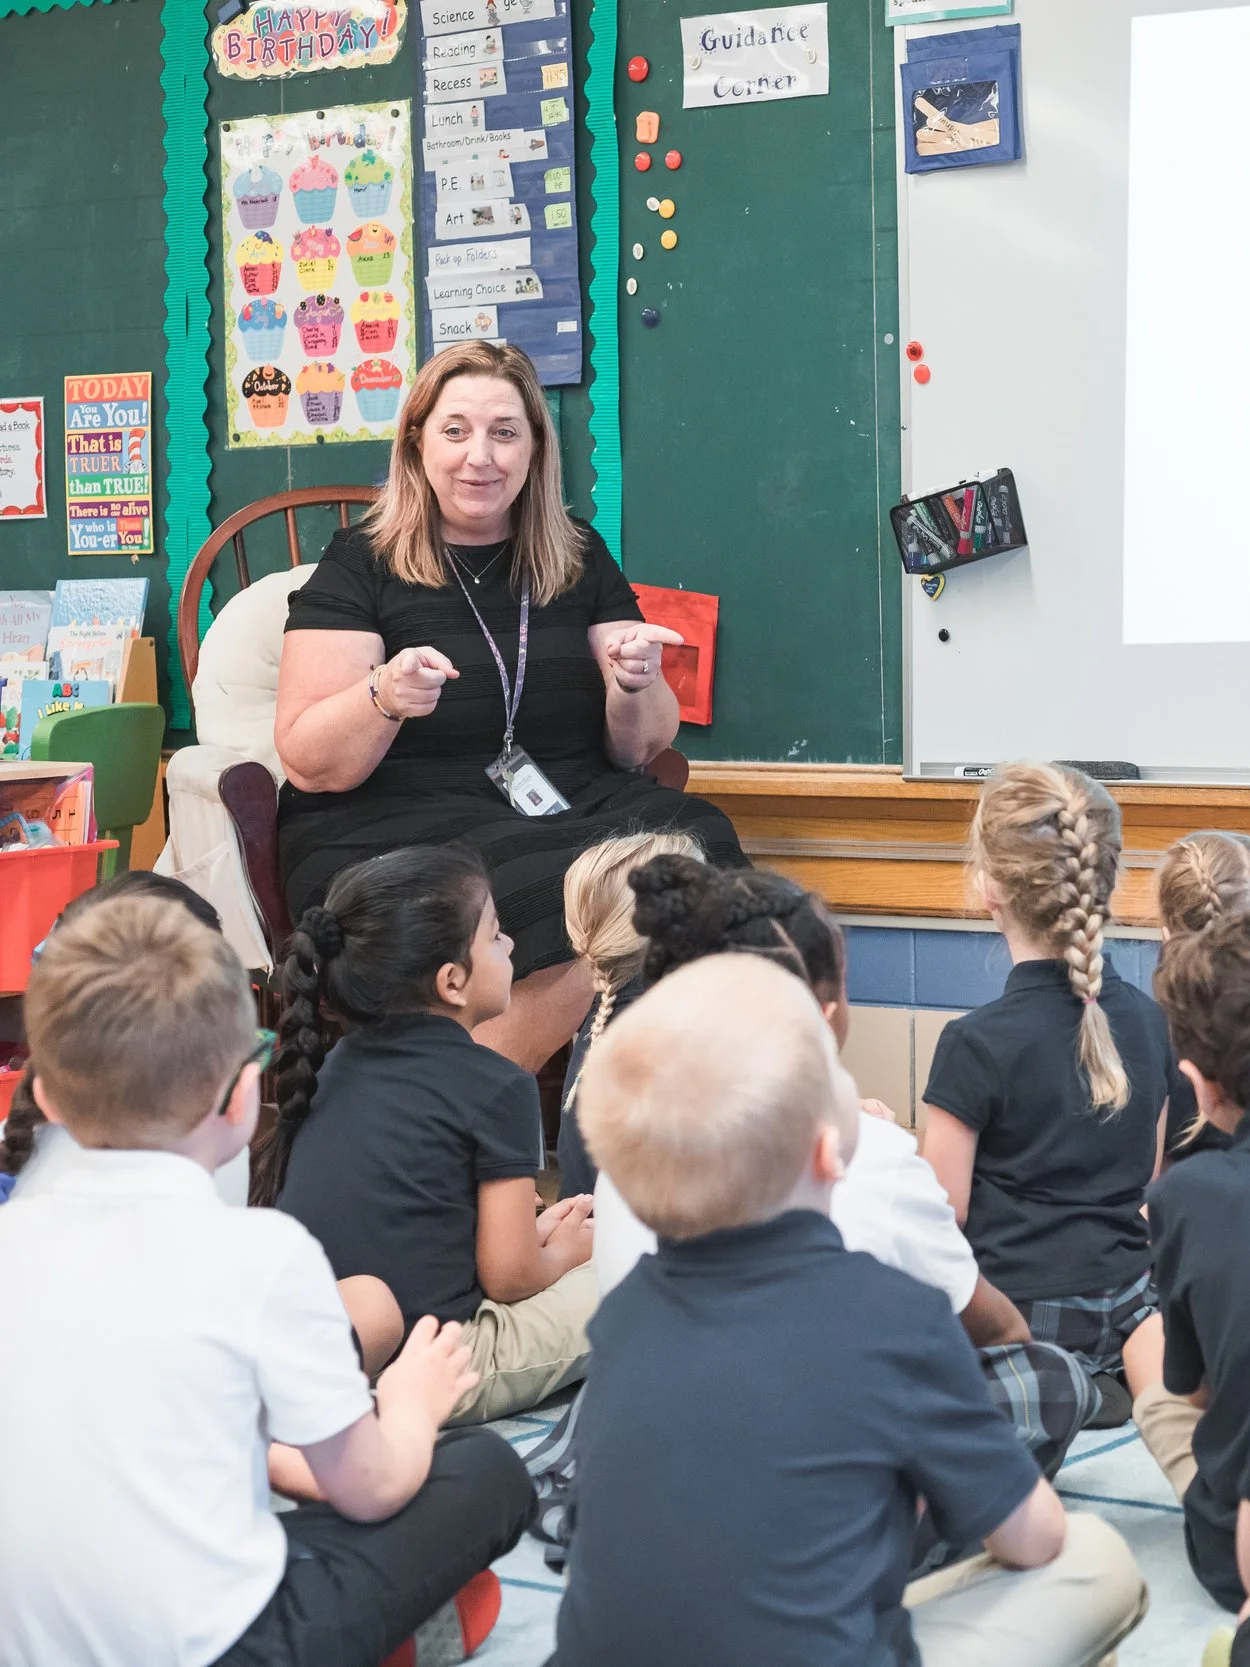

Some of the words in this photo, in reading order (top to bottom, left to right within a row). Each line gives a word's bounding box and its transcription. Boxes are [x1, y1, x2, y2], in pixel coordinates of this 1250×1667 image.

[255, 8, 348, 37] HAPPY
[433, 11, 475, 25] Science
[227, 9, 390, 62] BIRTHDAY!
[700, 24, 808, 51] Guidance
[433, 44, 476, 59] Reading
[433, 77, 471, 90] Recess
[713, 74, 797, 98] Corner
[431, 111, 464, 128] Lunch
[426, 132, 511, 151] Bathroom/Drink/Books
[441, 176, 461, 190] P.E.
[445, 214, 464, 226] Art
[466, 248, 497, 262] Folders
[433, 286, 473, 300] Learning
[476, 283, 506, 295] Choice
[439, 321, 472, 335] Snack
[69, 377, 148, 400] TODAY
[254, 380, 279, 392] October
[70, 410, 101, 427] Are
[102, 402, 147, 426] You!
[79, 405, 97, 413] You
[13, 420, 30, 431] Book
[68, 434, 106, 453] That
[109, 435, 121, 451] is
[70, 456, 121, 472] TRUER
[69, 479, 101, 494] than
[103, 475, 148, 494] TRUE!
[70, 505, 98, 517] There
[100, 504, 108, 516] is
[122, 502, 148, 516] alive
[85, 522, 104, 532] who
[107, 521, 116, 532] is
[71, 524, 117, 549] You-er
[52, 683, 80, 698] ABC
[45, 701, 71, 716] Like
